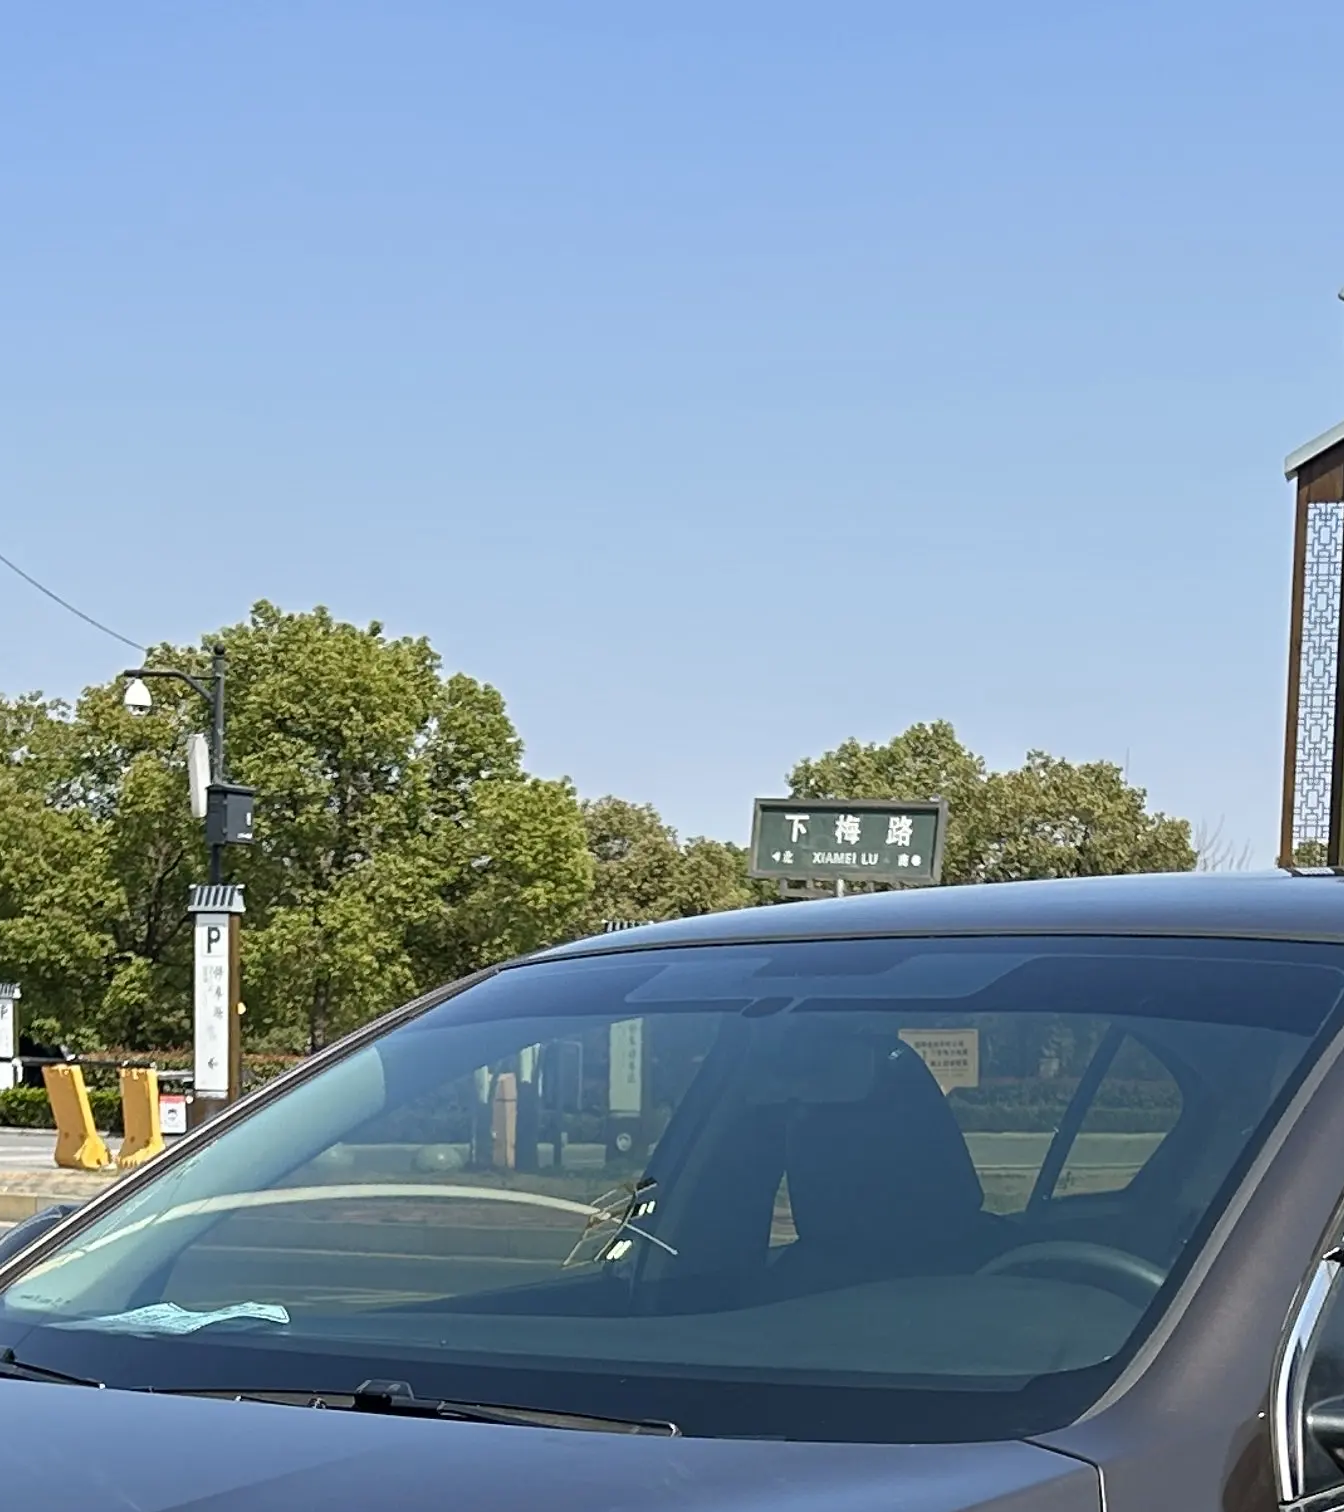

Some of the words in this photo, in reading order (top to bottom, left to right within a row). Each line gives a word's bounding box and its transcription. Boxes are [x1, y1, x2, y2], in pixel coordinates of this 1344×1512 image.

[784, 814, 913, 847] 下梅路
[782, 850, 794, 864] 北
[812, 851, 856, 865] XIAMEI
[861, 853, 879, 865] LU
[207, 926, 221, 954] P
